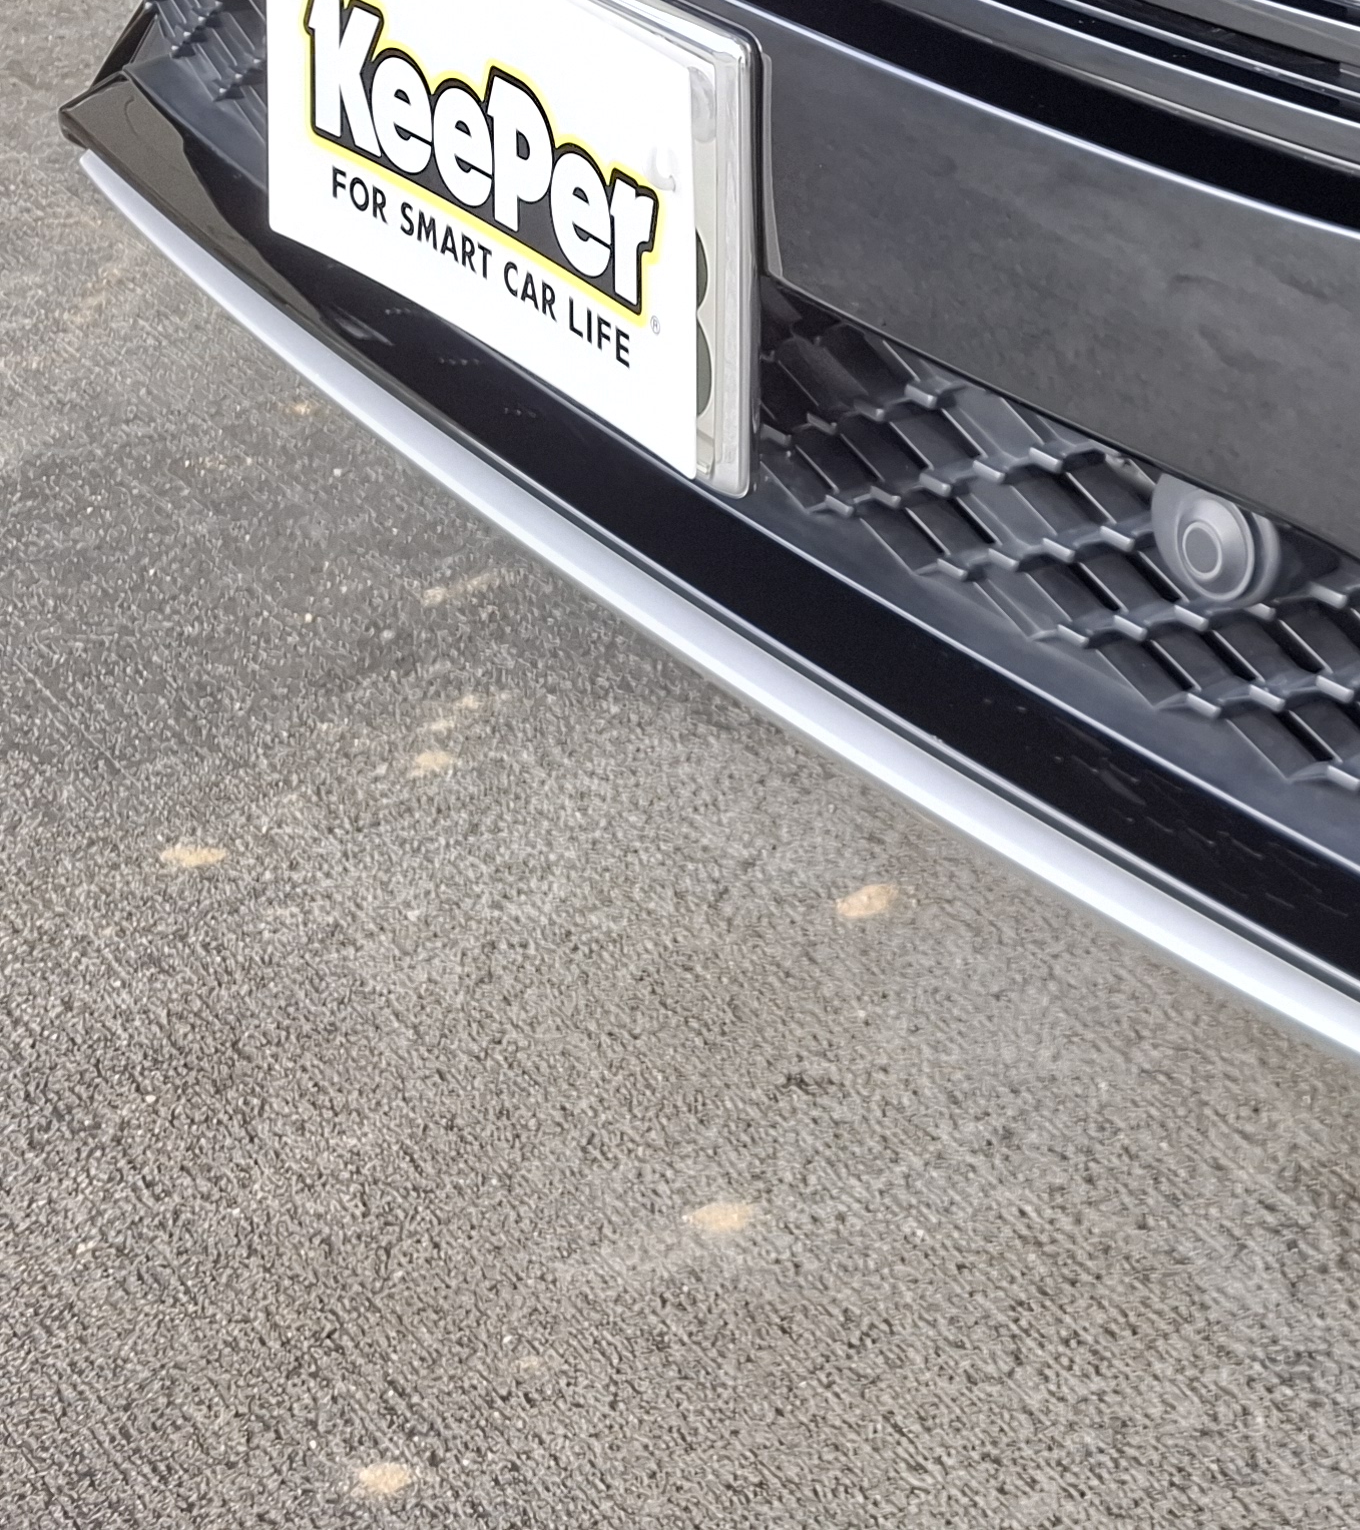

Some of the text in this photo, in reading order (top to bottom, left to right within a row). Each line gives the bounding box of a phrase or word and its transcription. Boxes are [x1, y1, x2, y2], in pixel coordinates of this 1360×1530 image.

[332, 166, 631, 369] FOR SMART CAR LIFE
